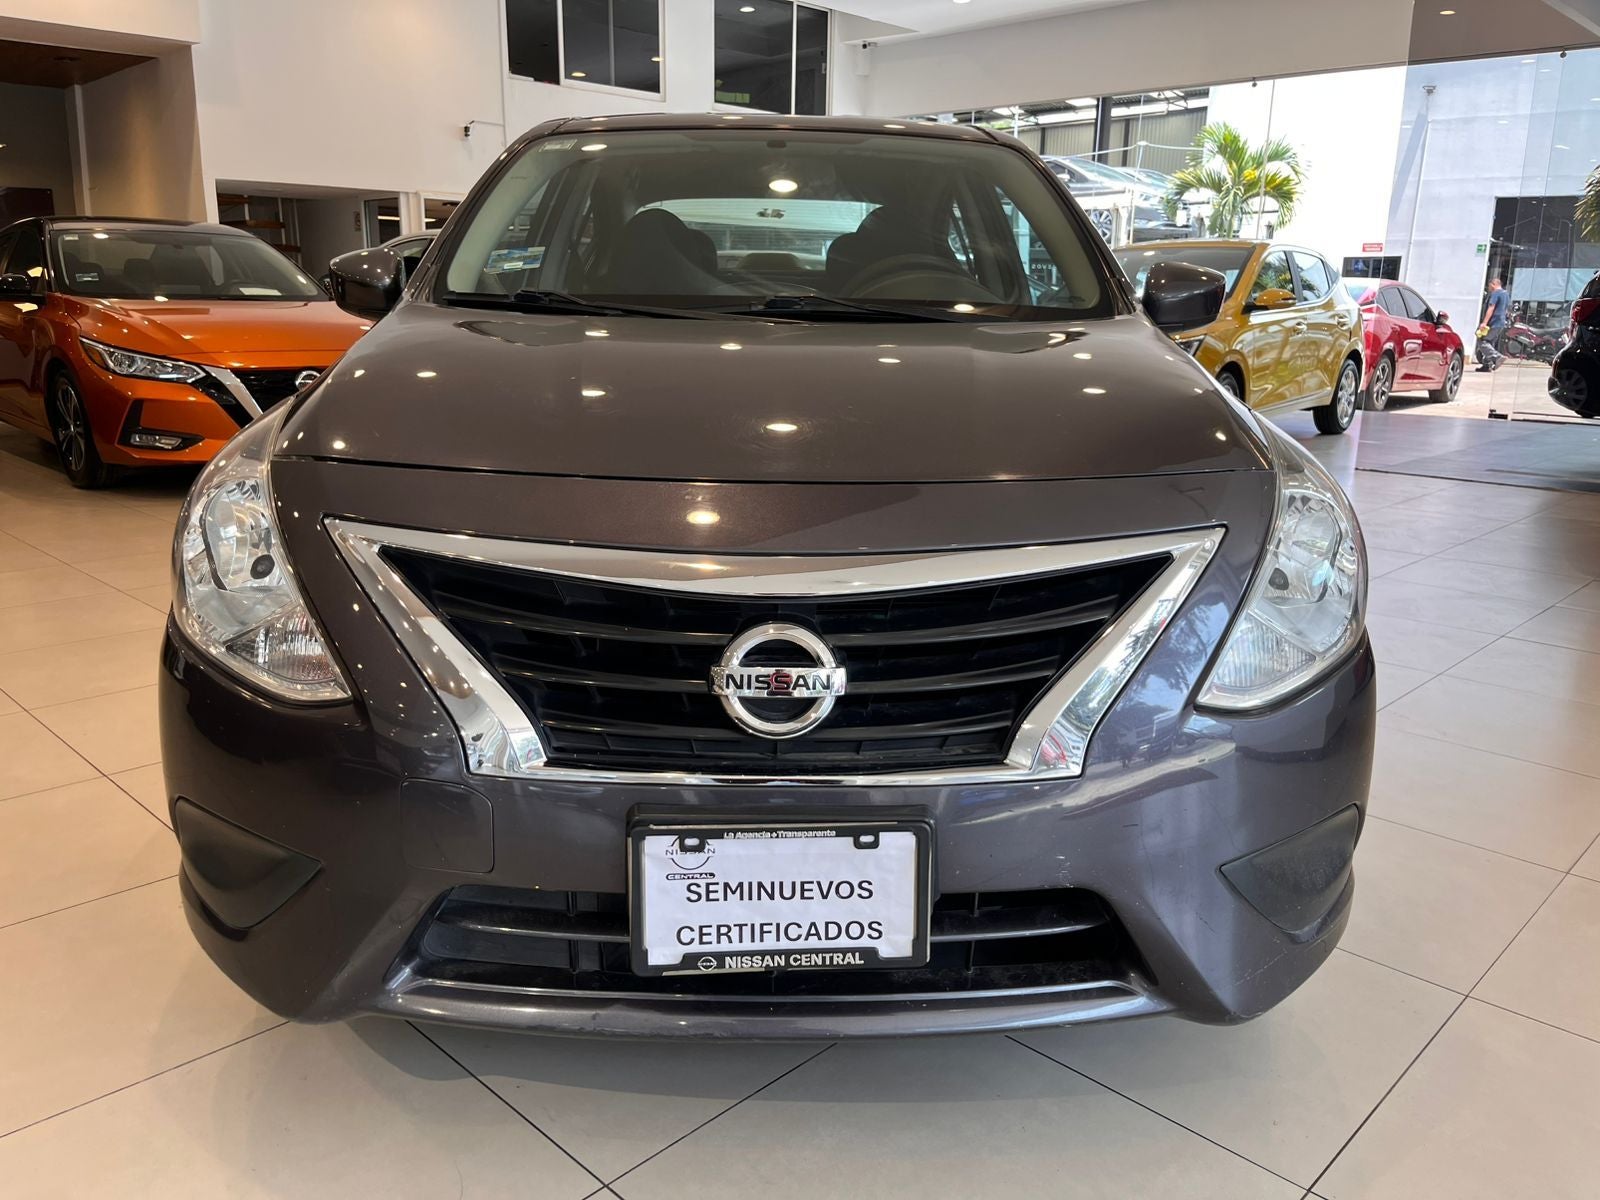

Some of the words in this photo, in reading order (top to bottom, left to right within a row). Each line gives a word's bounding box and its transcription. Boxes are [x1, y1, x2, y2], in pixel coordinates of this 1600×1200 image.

[725, 673, 831, 690] NISSAN
[668, 872, 714, 880] CENTRAL
[686, 880, 874, 903] SEMINUEVOS
[676, 921, 883, 946] CERTIFICADOS
[725, 954, 785, 969] NISSAN
[790, 952, 864, 966] CENTRAL
